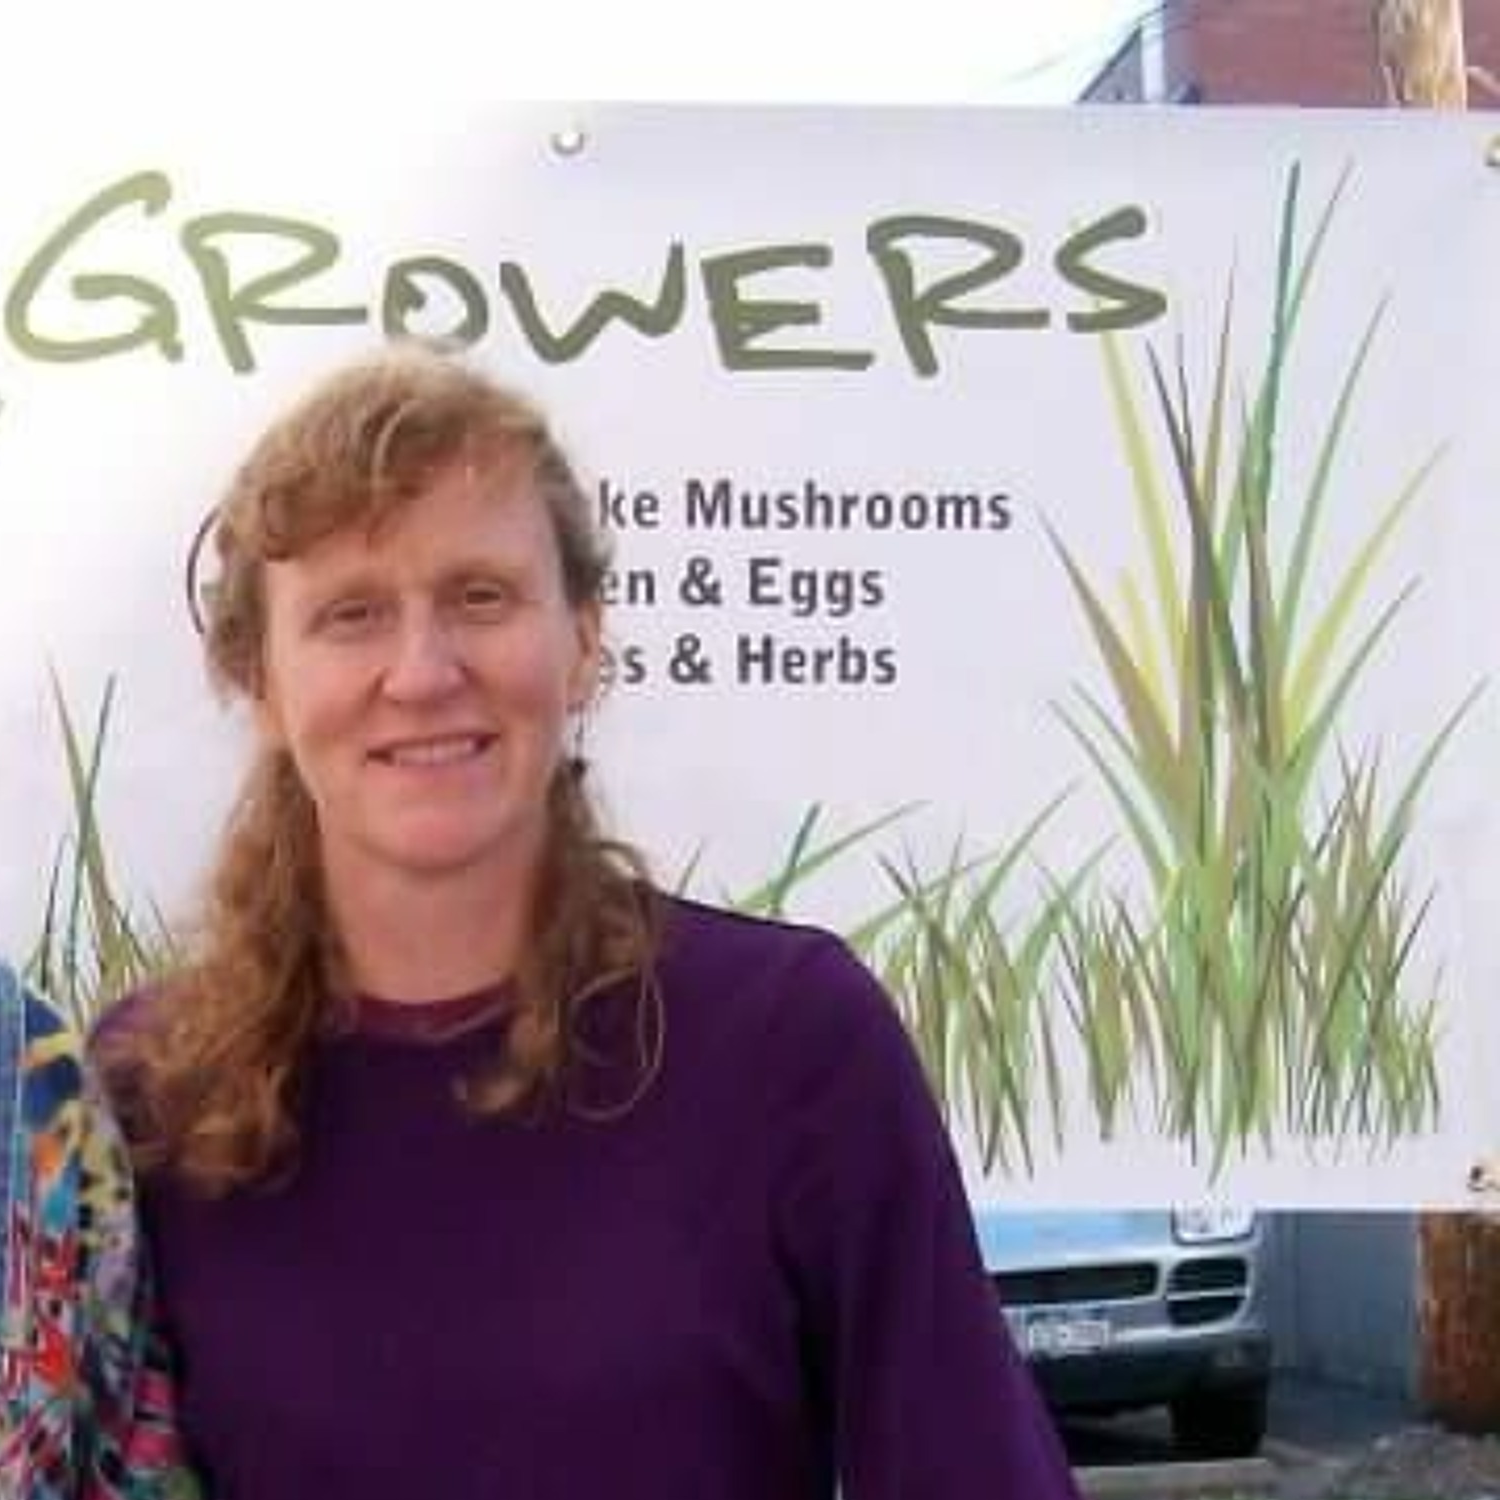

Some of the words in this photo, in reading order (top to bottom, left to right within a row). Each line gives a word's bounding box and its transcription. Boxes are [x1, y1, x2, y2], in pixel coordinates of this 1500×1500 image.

[4, 170, 1168, 376] GROWERS
[685, 479, 1012, 530] Mushrooms
[678, 556, 722, 606] &
[747, 556, 885, 618] Eggs
[669, 633, 714, 685] &
[737, 633, 898, 685] Herbs
